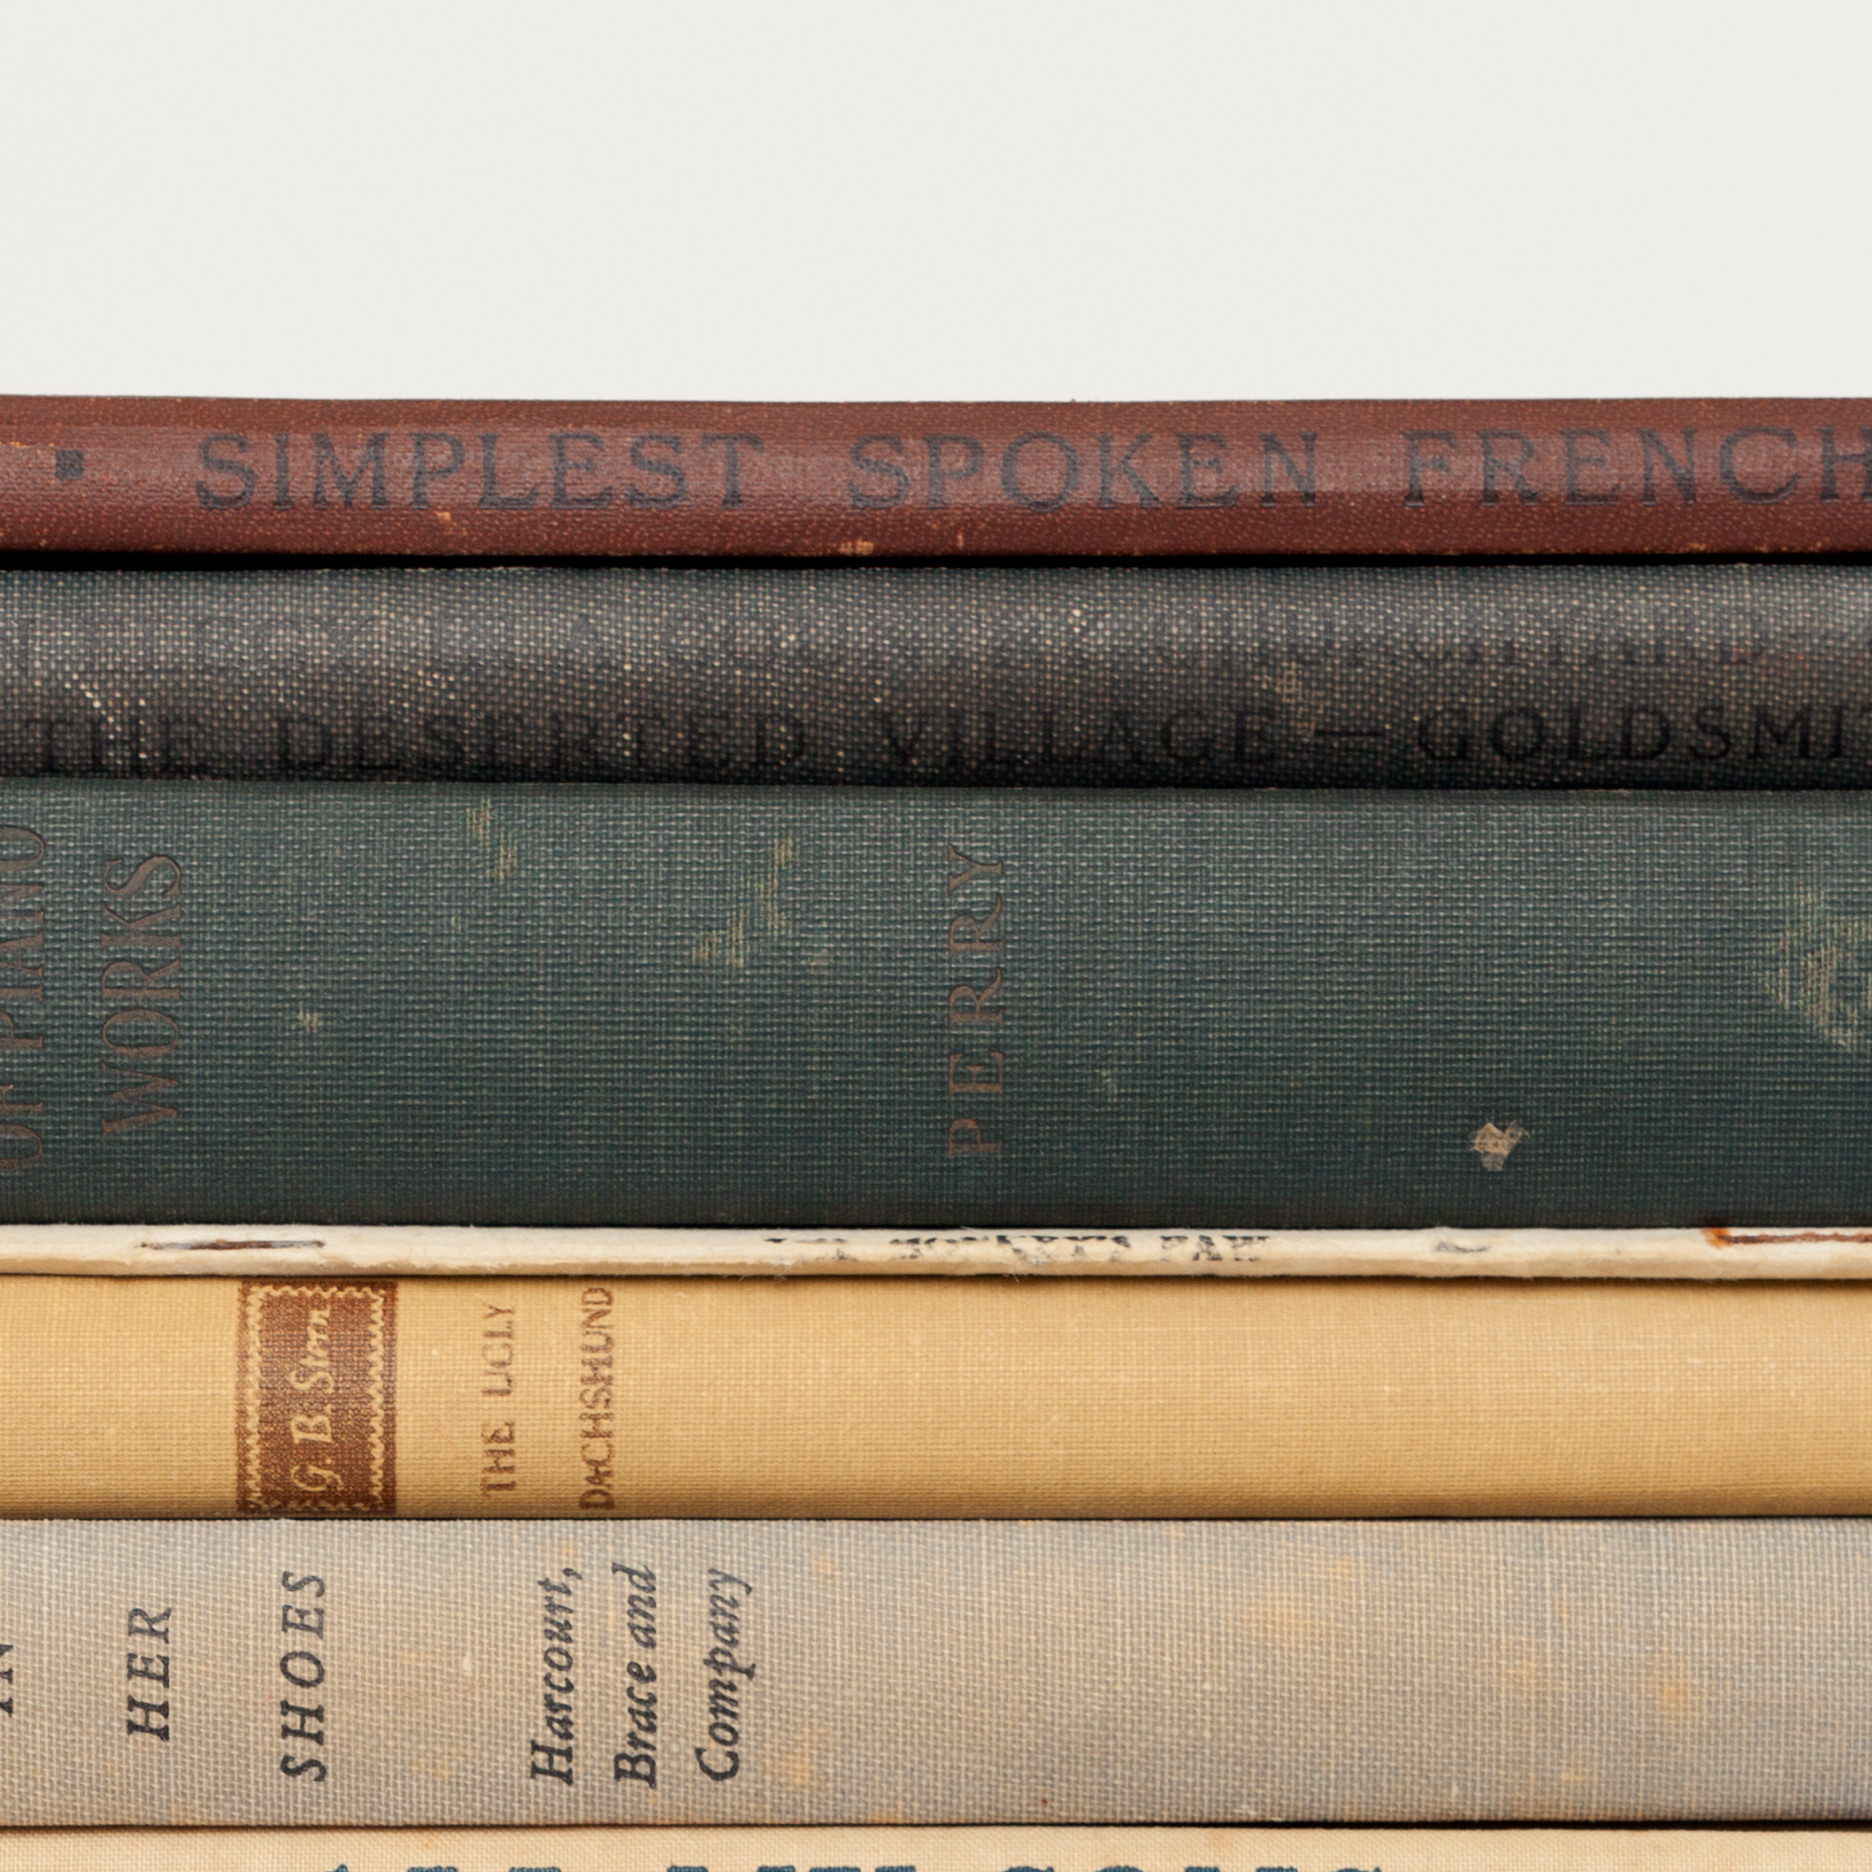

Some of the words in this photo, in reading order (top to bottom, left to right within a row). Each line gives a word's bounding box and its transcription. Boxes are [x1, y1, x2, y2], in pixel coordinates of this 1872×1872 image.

[195, 431, 768, 512] SIMPLEST
[847, 430, 1320, 512] SPOKEN
[20, 714, 208, 774] THE
[275, 710, 808, 775] DESERTED
[871, 708, 1281, 768] VILLAGE
[101, 854, 182, 1138] WORKS
[947, 842, 1004, 1156] PERRY
[481, 1303, 516, 1397] UGLY
[579, 1287, 615, 1510] DACHSHUND
[481, 1421, 516, 1499] THE
[127, 1606, 171, 1742] HER
[611, 1562, 657, 1650] and
[280, 1570, 326, 1783] SHOES
[530, 1567, 583, 1787] Harcourt,
[613, 1660, 657, 1789] Brace
[694, 1567, 756, 1782] Company
